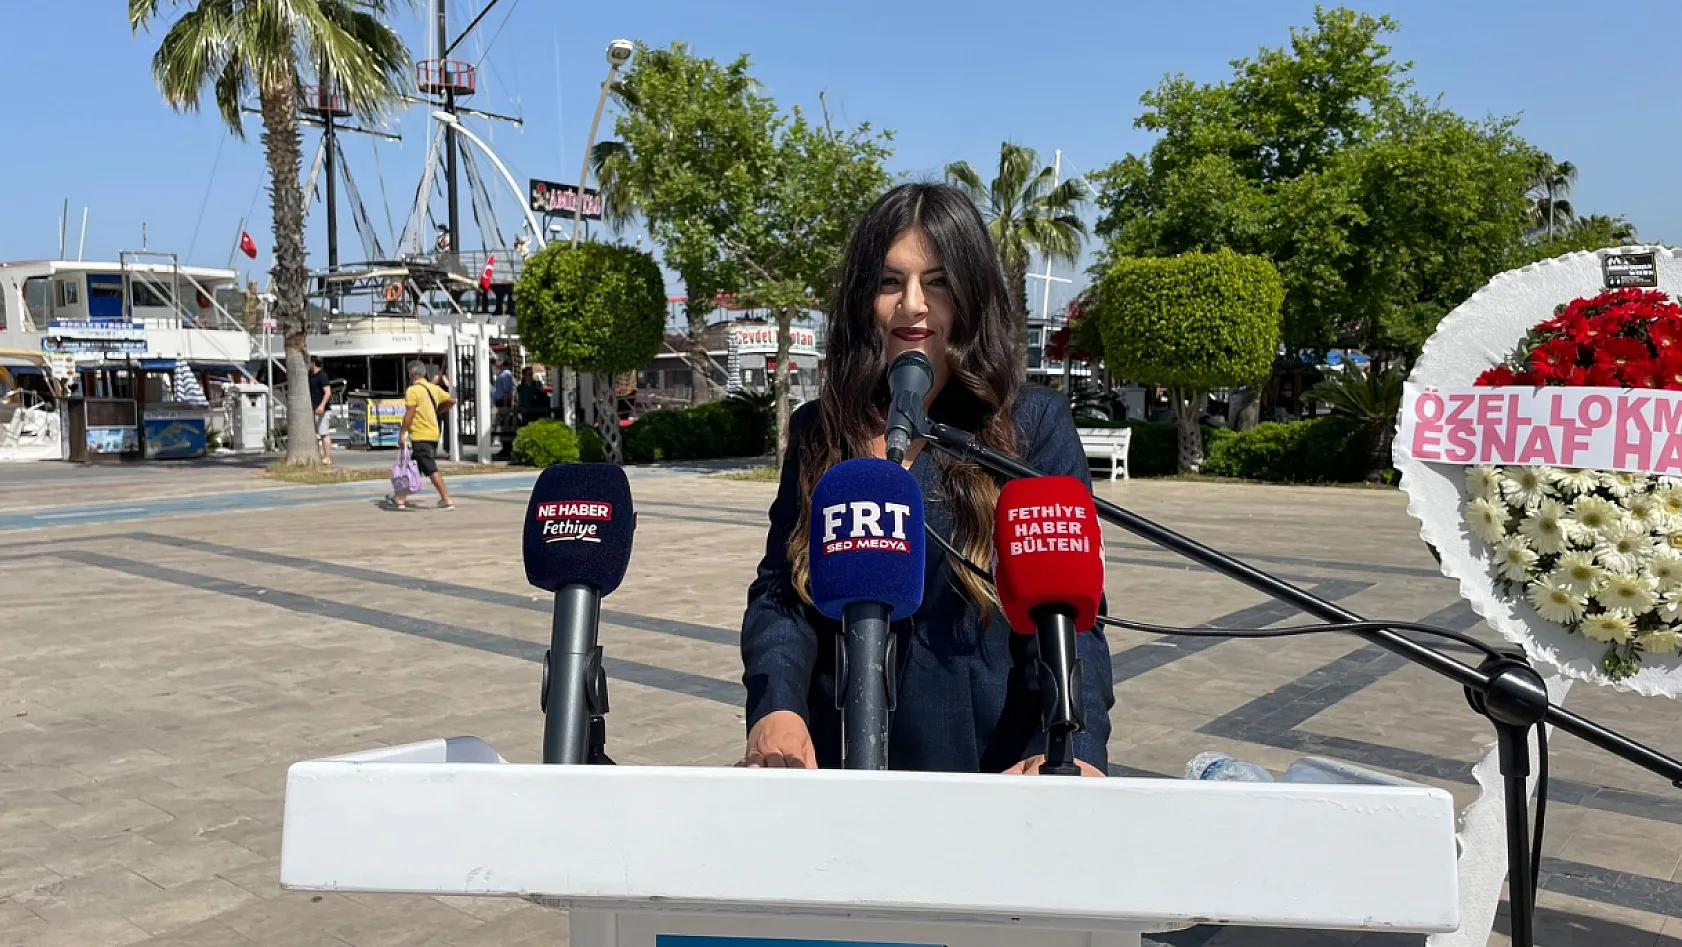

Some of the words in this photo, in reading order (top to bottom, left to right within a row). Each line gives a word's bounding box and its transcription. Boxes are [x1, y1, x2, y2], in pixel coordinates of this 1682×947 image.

[735, 329, 772, 344] Cevdet
[1414, 387, 1532, 426] ÖZEL
[1550, 394, 1682, 433] LOKM
[1411, 421, 1593, 465] ESNAF
[1612, 429, 1682, 473] HA
[538, 504, 557, 517] NE
[558, 503, 609, 517] HABER
[1008, 503, 1087, 522] FETHİYE
[542, 519, 598, 539] Fethiye
[822, 501, 911, 543] FRT
[1014, 521, 1082, 537] HABER
[826, 540, 853, 553] SED
[856, 539, 907, 551] MEDYA
[1010, 536, 1090, 556] BÜLTENİ
